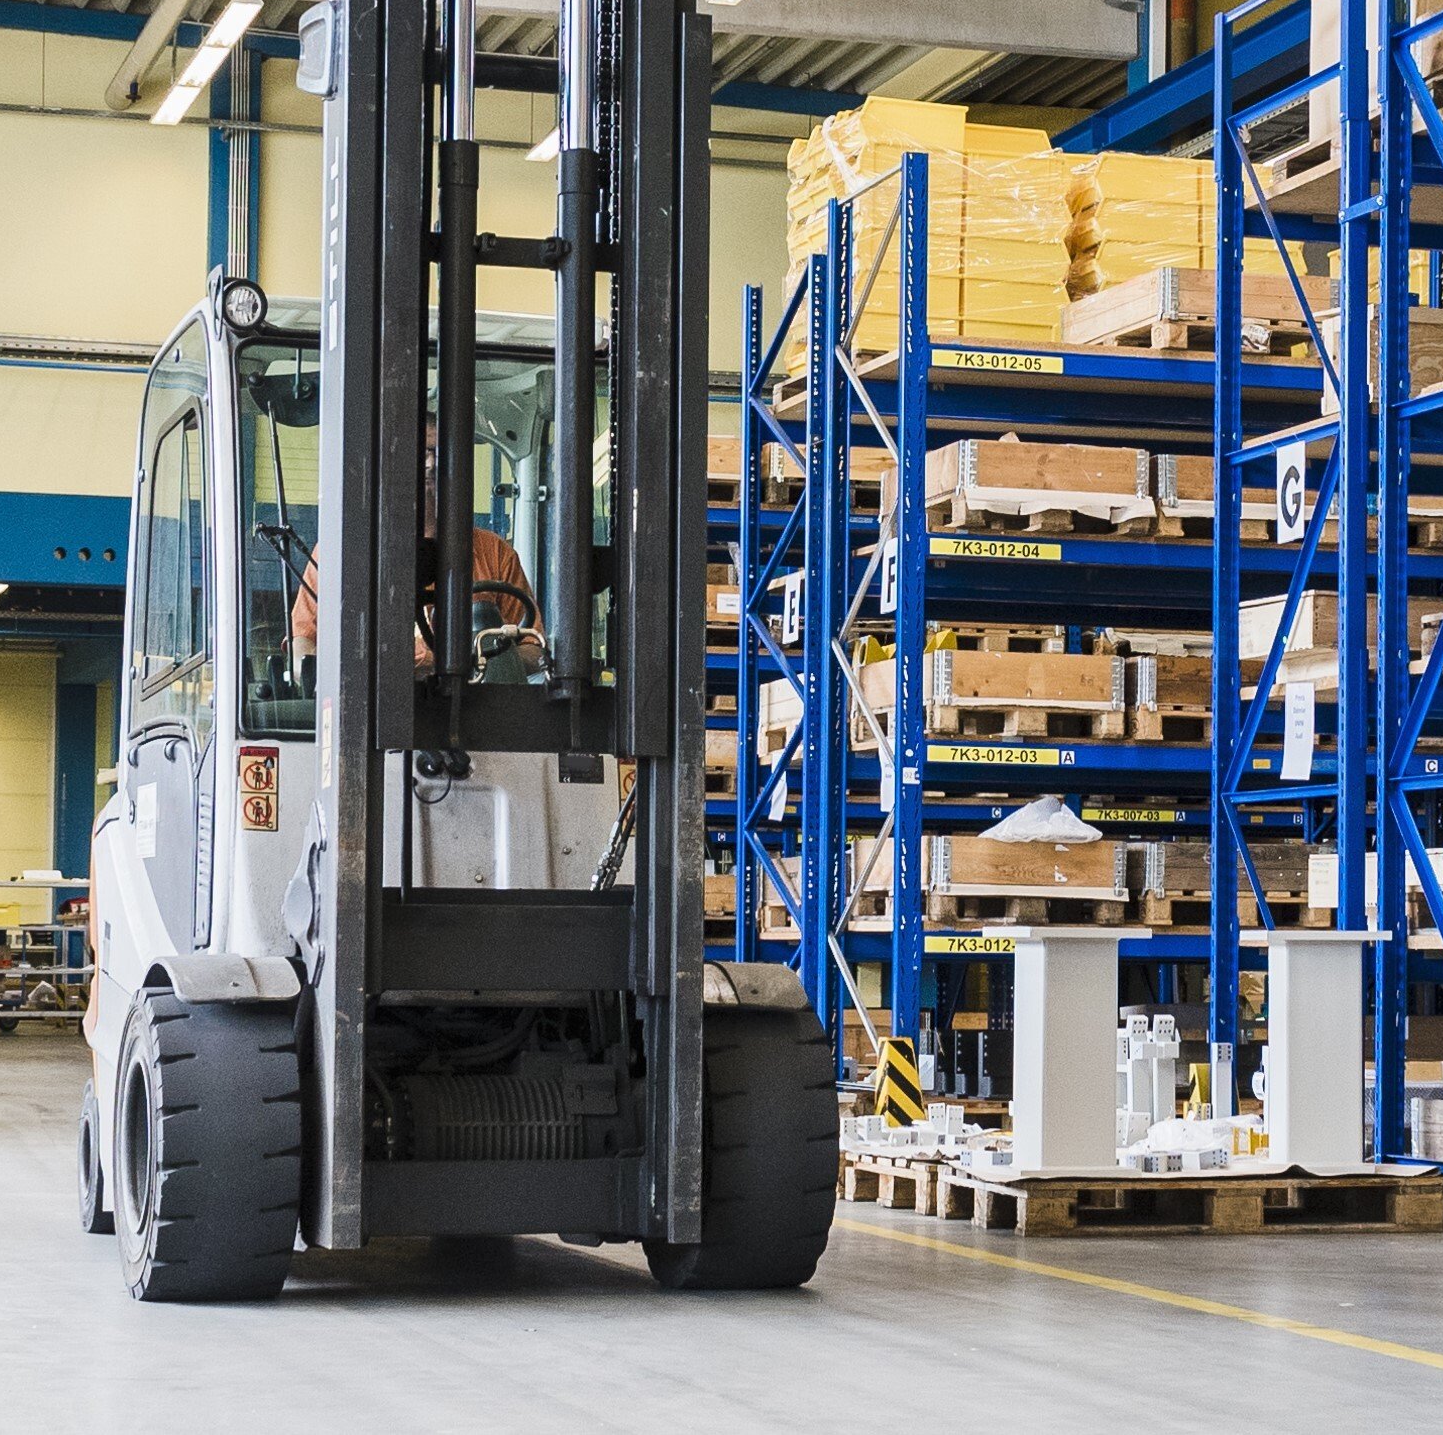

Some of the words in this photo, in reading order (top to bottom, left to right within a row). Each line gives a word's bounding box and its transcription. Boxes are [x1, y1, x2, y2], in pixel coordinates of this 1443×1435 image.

[955, 353, 1042, 370] 7K3-012-05
[1281, 465, 1302, 529] G
[953, 541, 1040, 558] 7K3-012-04
[887, 555, 896, 604] F
[789, 590, 797, 634] E
[950, 748, 1038, 763] 7K3-012-03
[1063, 752, 1073, 763] A
[1427, 760, 1437, 772] C
[1097, 810, 1160, 821] 7K3-007-03
[1176, 811, 1185, 821] A
[948, 938, 1015, 952] 7K3-012-
